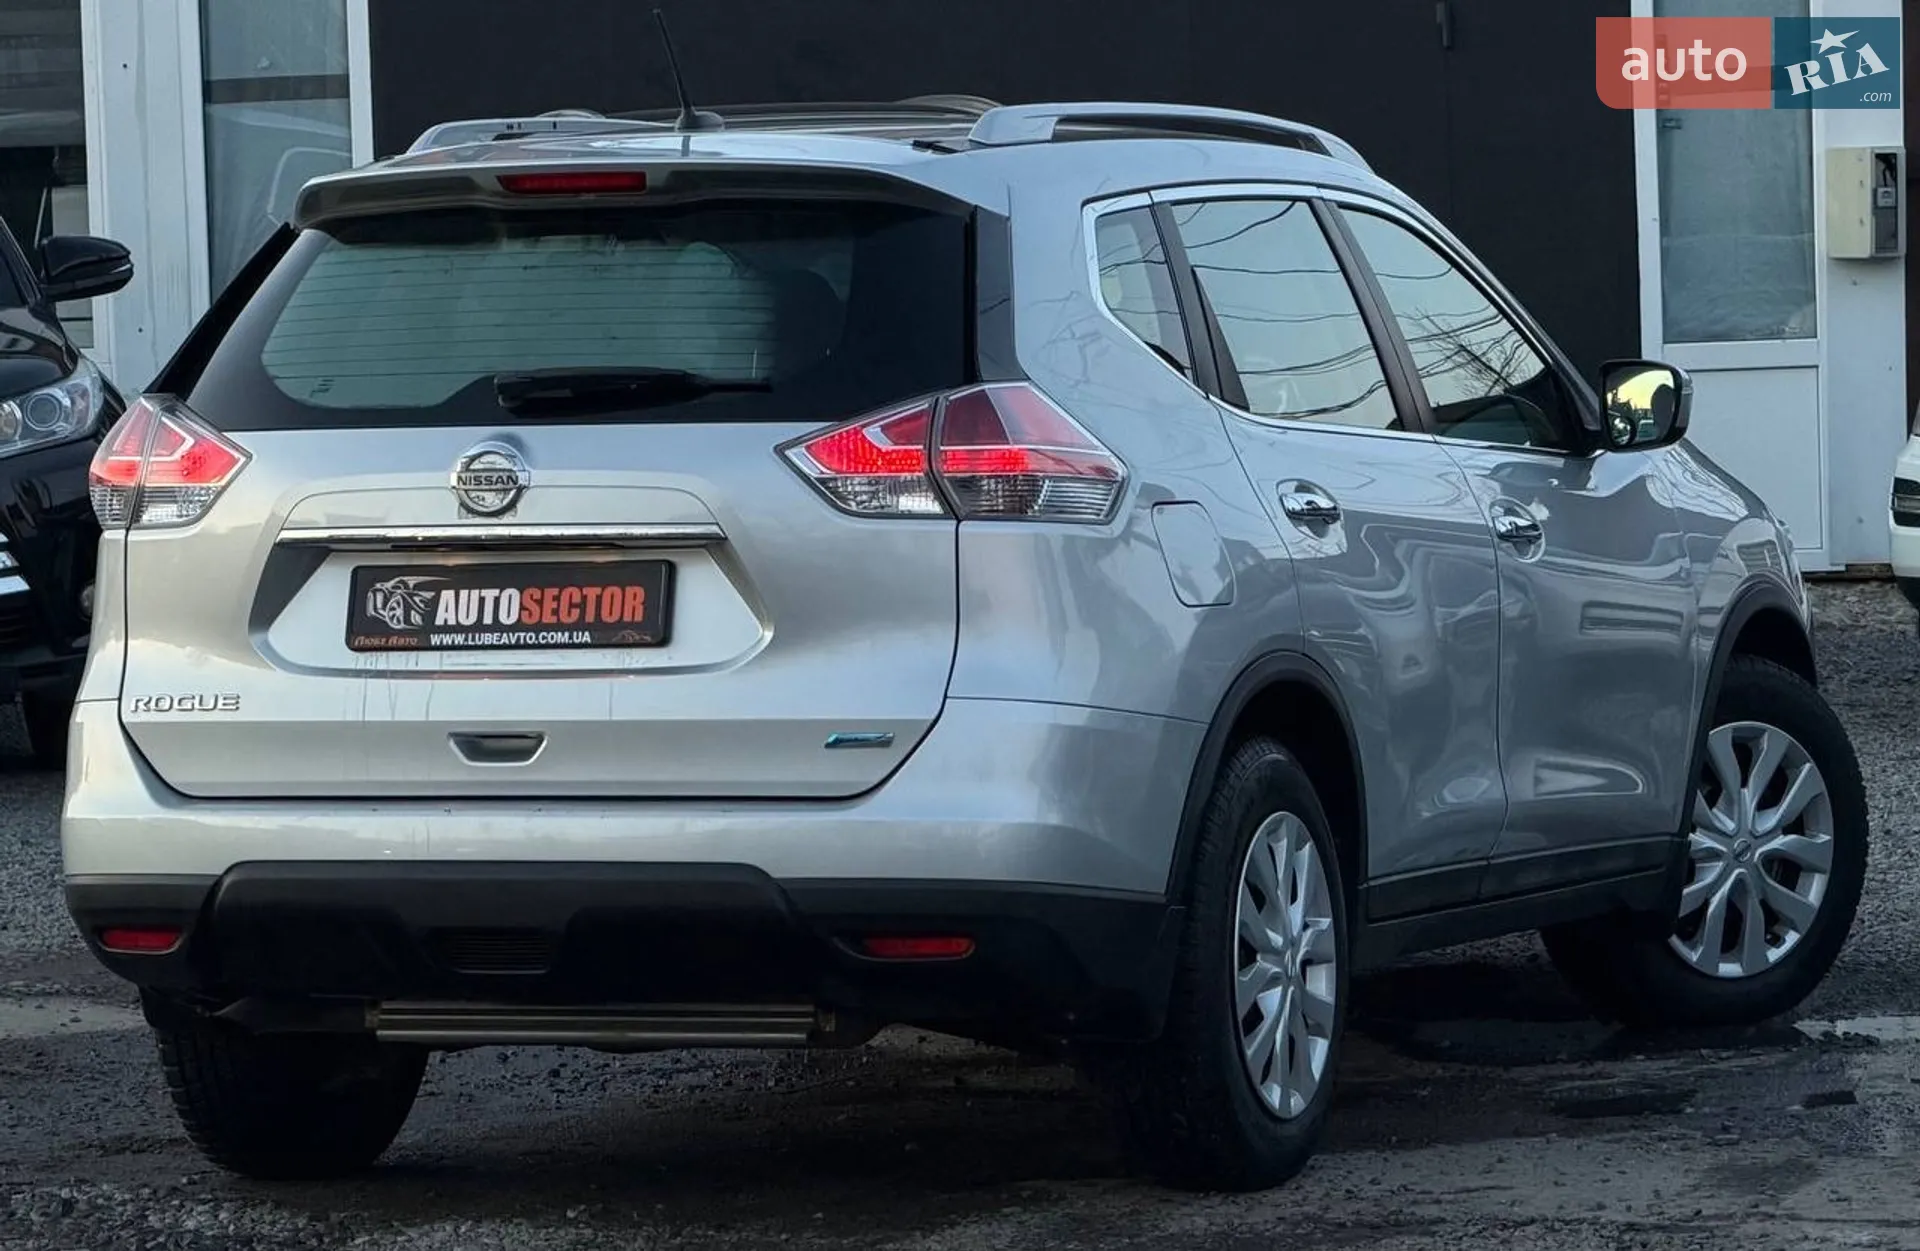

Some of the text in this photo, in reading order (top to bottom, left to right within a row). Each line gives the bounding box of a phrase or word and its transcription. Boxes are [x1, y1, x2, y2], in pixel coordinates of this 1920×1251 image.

[457, 474, 519, 486] NISSAN
[434, 586, 646, 626] AUTOSECTOR
[430, 631, 592, 646] WWW.LUBEAVTO.COM.UA
[130, 692, 241, 713] ROGUE
